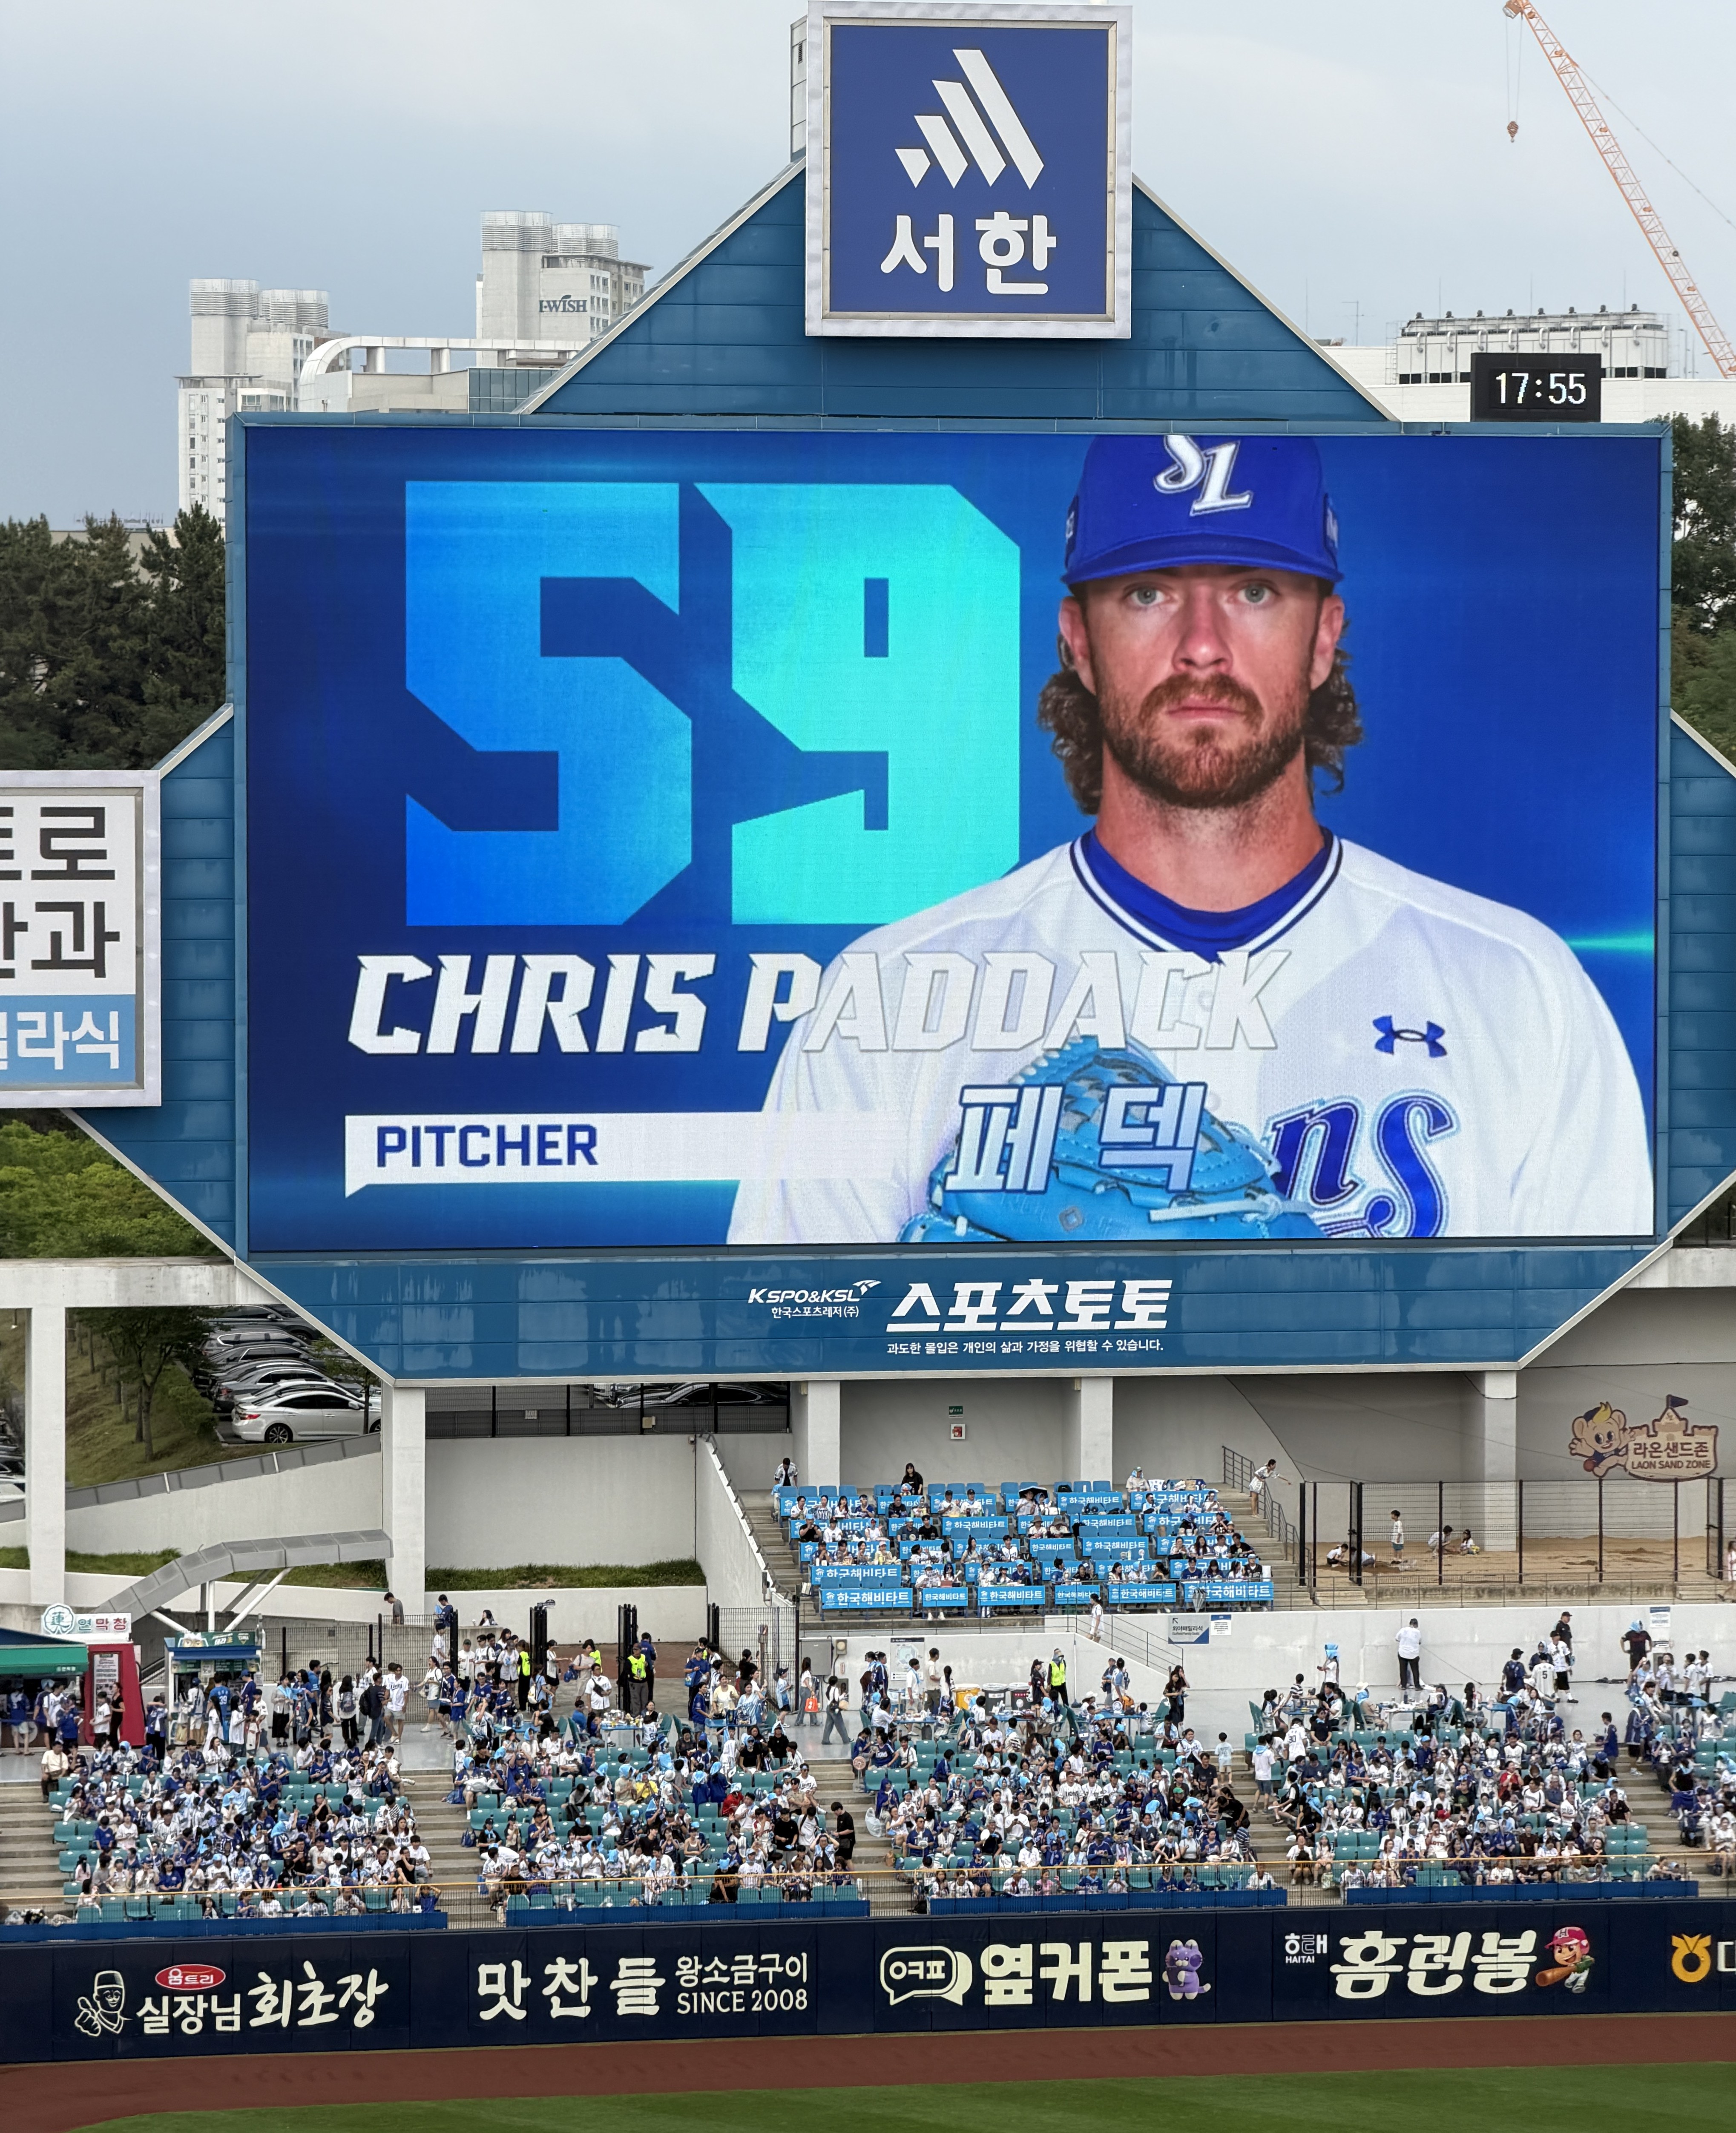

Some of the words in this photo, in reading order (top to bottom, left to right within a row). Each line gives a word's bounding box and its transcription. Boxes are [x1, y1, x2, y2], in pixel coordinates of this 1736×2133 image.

[880, 212, 1057, 295] 서한
[1495, 372, 1587, 404] 17:55
[406, 481, 1020, 926] 59
[0, 806, 115, 880] 로
[348, 953, 716, 1054] CHRIS
[737, 950, 1292, 1053] PADDACK
[0, 1011, 119, 1070] 라식
[377, 1124, 599, 1167] PITCHER
[748, 1288, 860, 1303] KSPO&KSL
[885, 1279, 1173, 1333] 스포츠토토
[887, 1342, 921, 1354] 과도한
[925, 1342, 959, 1354] 몰입은
[963, 1341, 996, 1354] 개인의
[1000, 1341, 1023, 1353] 삶과
[1027, 1340, 1061, 1353] 가정을
[1064, 1340, 1098, 1352] 위협할
[1101, 1340, 1113, 1351] 수
[1116, 1339, 1164, 1351] 있습니다.
[1631, 1460, 1656, 1469] LAON
[1658, 1460, 1684, 1469] SAND
[1685, 1460, 1711, 1469] ZONE
[836, 1591, 909, 1605] 한국해비타트
[989, 1590, 1043, 1601] 한국해비타트
[219, 1695, 227, 1705] 39
[675, 1952, 808, 1988] 왕소금구이
[980, 1940, 1153, 2005] 옆커폰
[1285, 1955, 1315, 1964] HAITAI
[1329, 1930, 1538, 1999] 홈런볼
[137, 1994, 241, 2035] 실장님
[248, 1960, 389, 2028] 회초장
[676, 1991, 745, 2015] SINCE
[750, 1989, 808, 2012] 2008
